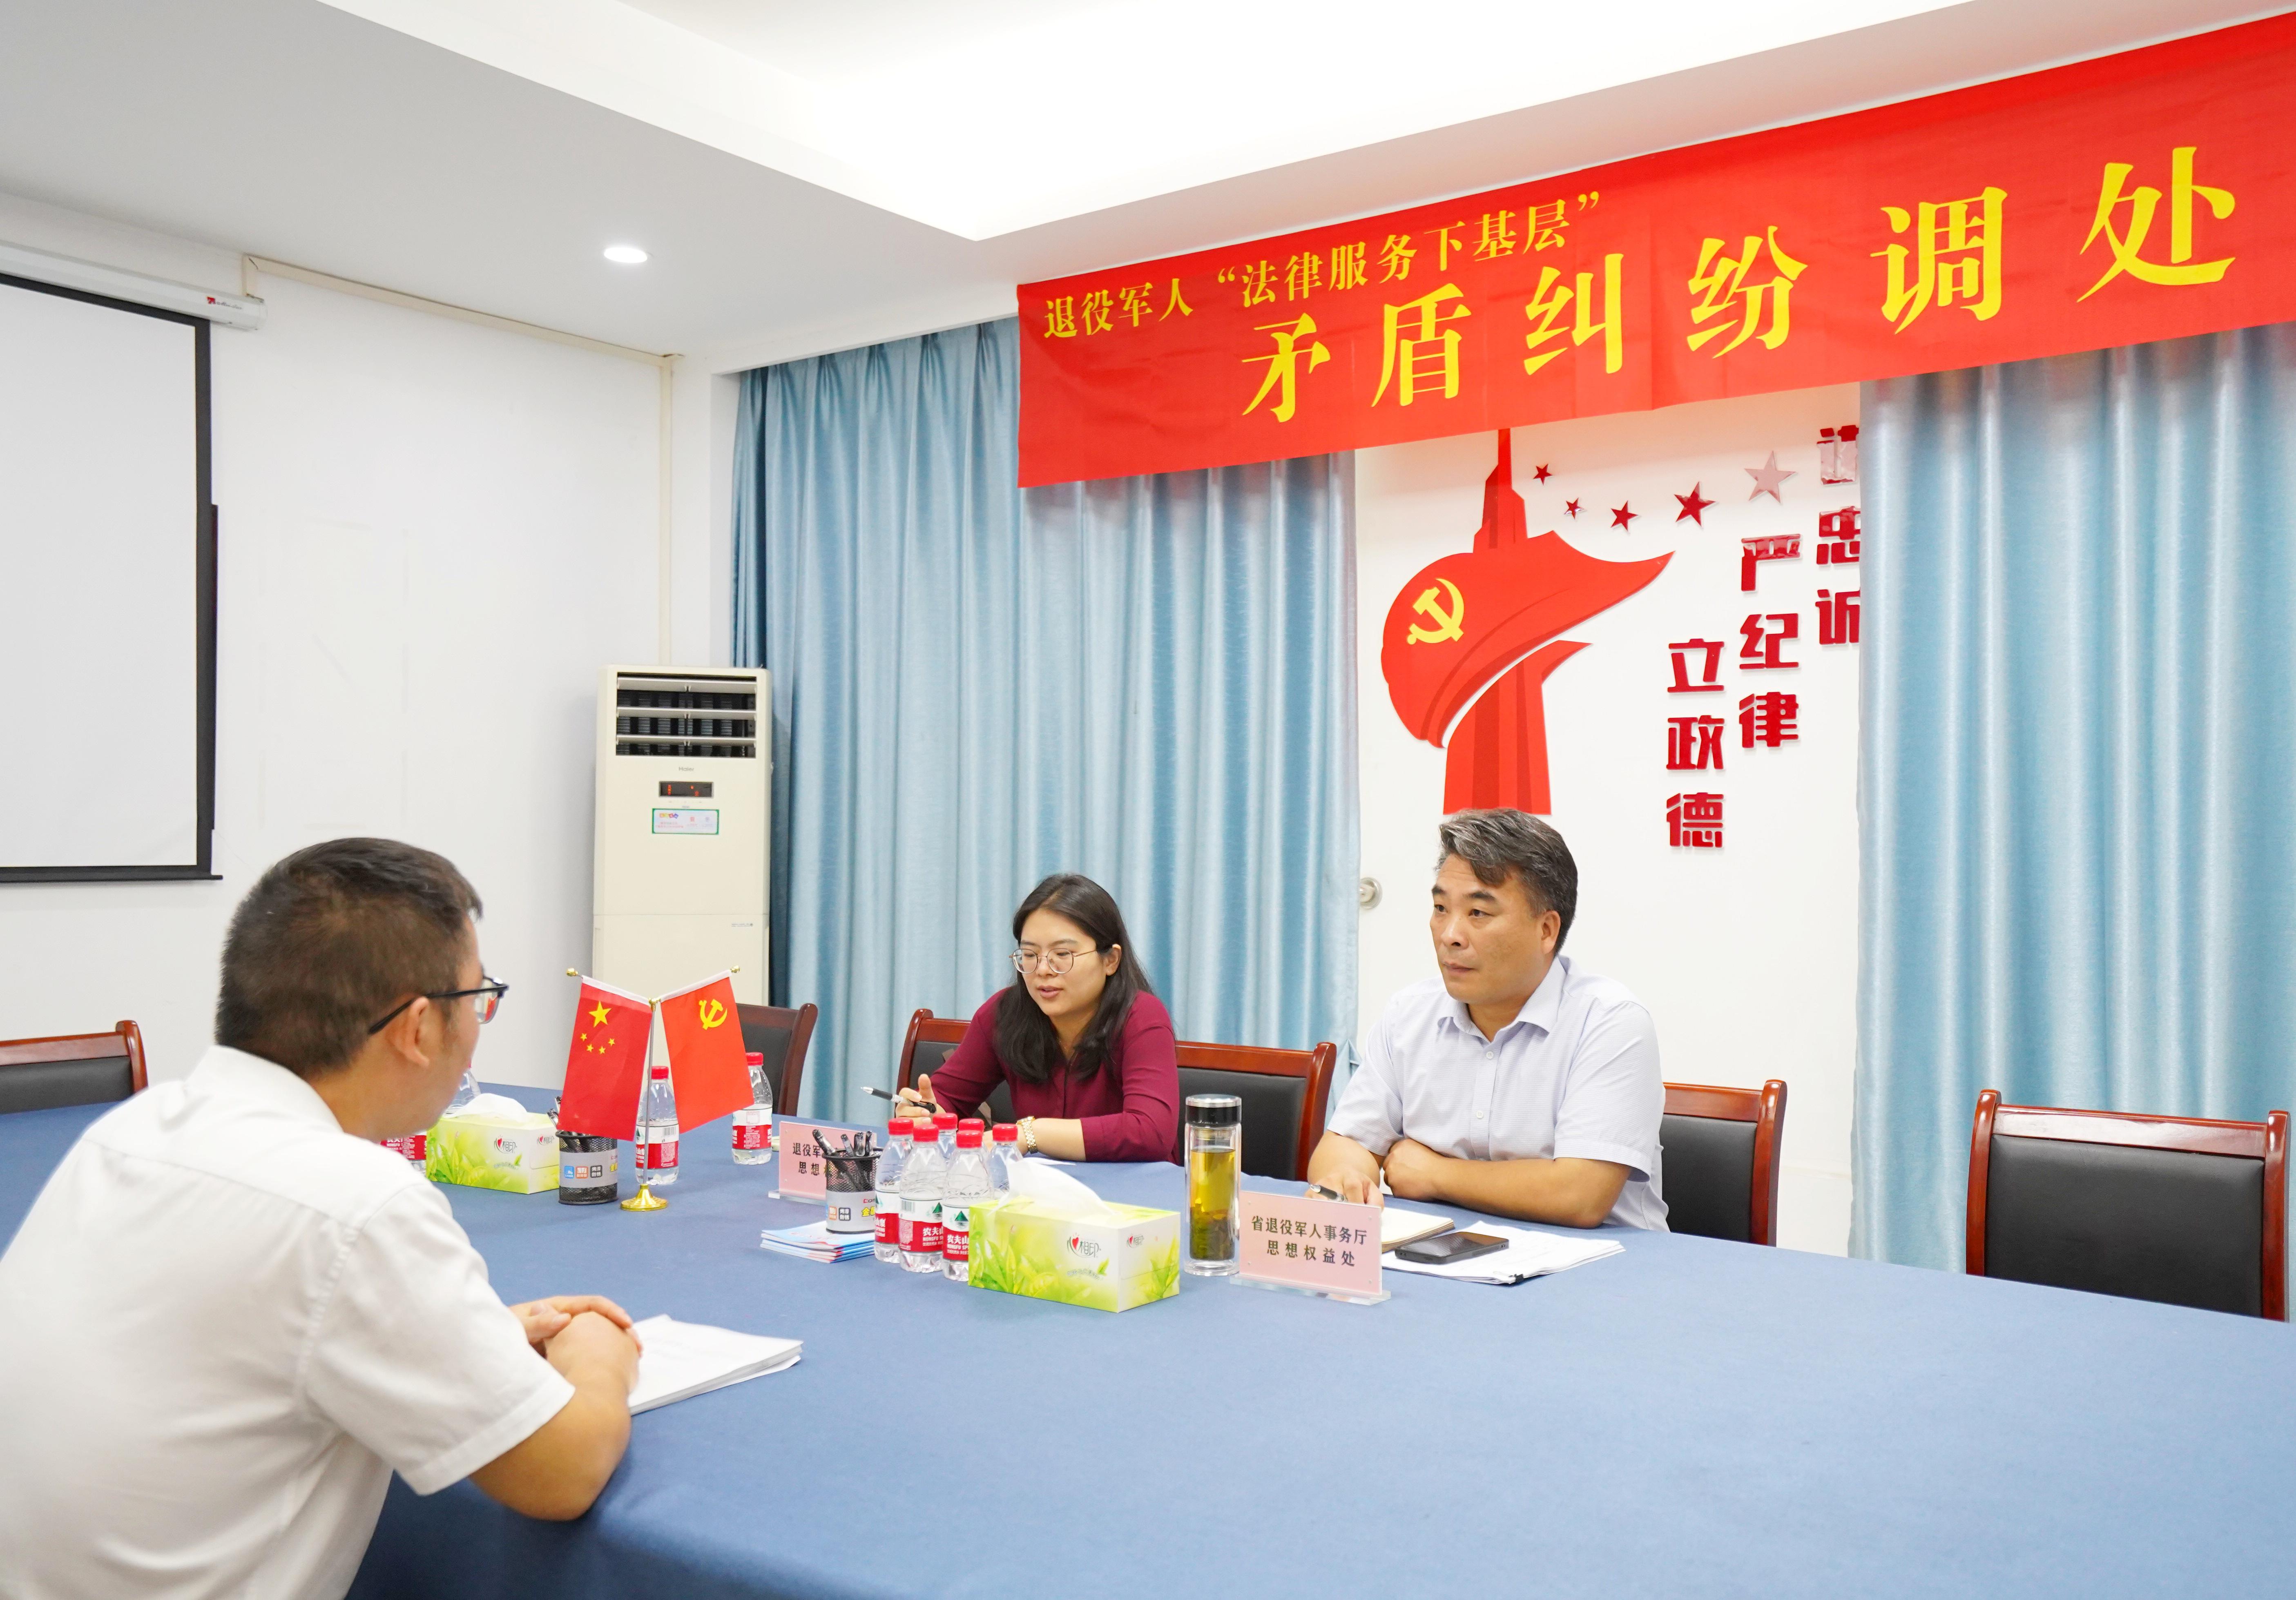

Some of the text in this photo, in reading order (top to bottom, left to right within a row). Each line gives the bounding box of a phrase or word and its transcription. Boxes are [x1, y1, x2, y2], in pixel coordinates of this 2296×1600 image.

[1242, 147, 2236, 423] 矛盾纠纷调处
[1739, 534, 1801, 748] 严纪律
[1666, 638, 1725, 848] 立政德
[792, 1143, 821, 1158] 退役军
[1252, 1215, 1367, 1245] 省退役军人事务厅
[1267, 1240, 1355, 1266] 思想权益处
